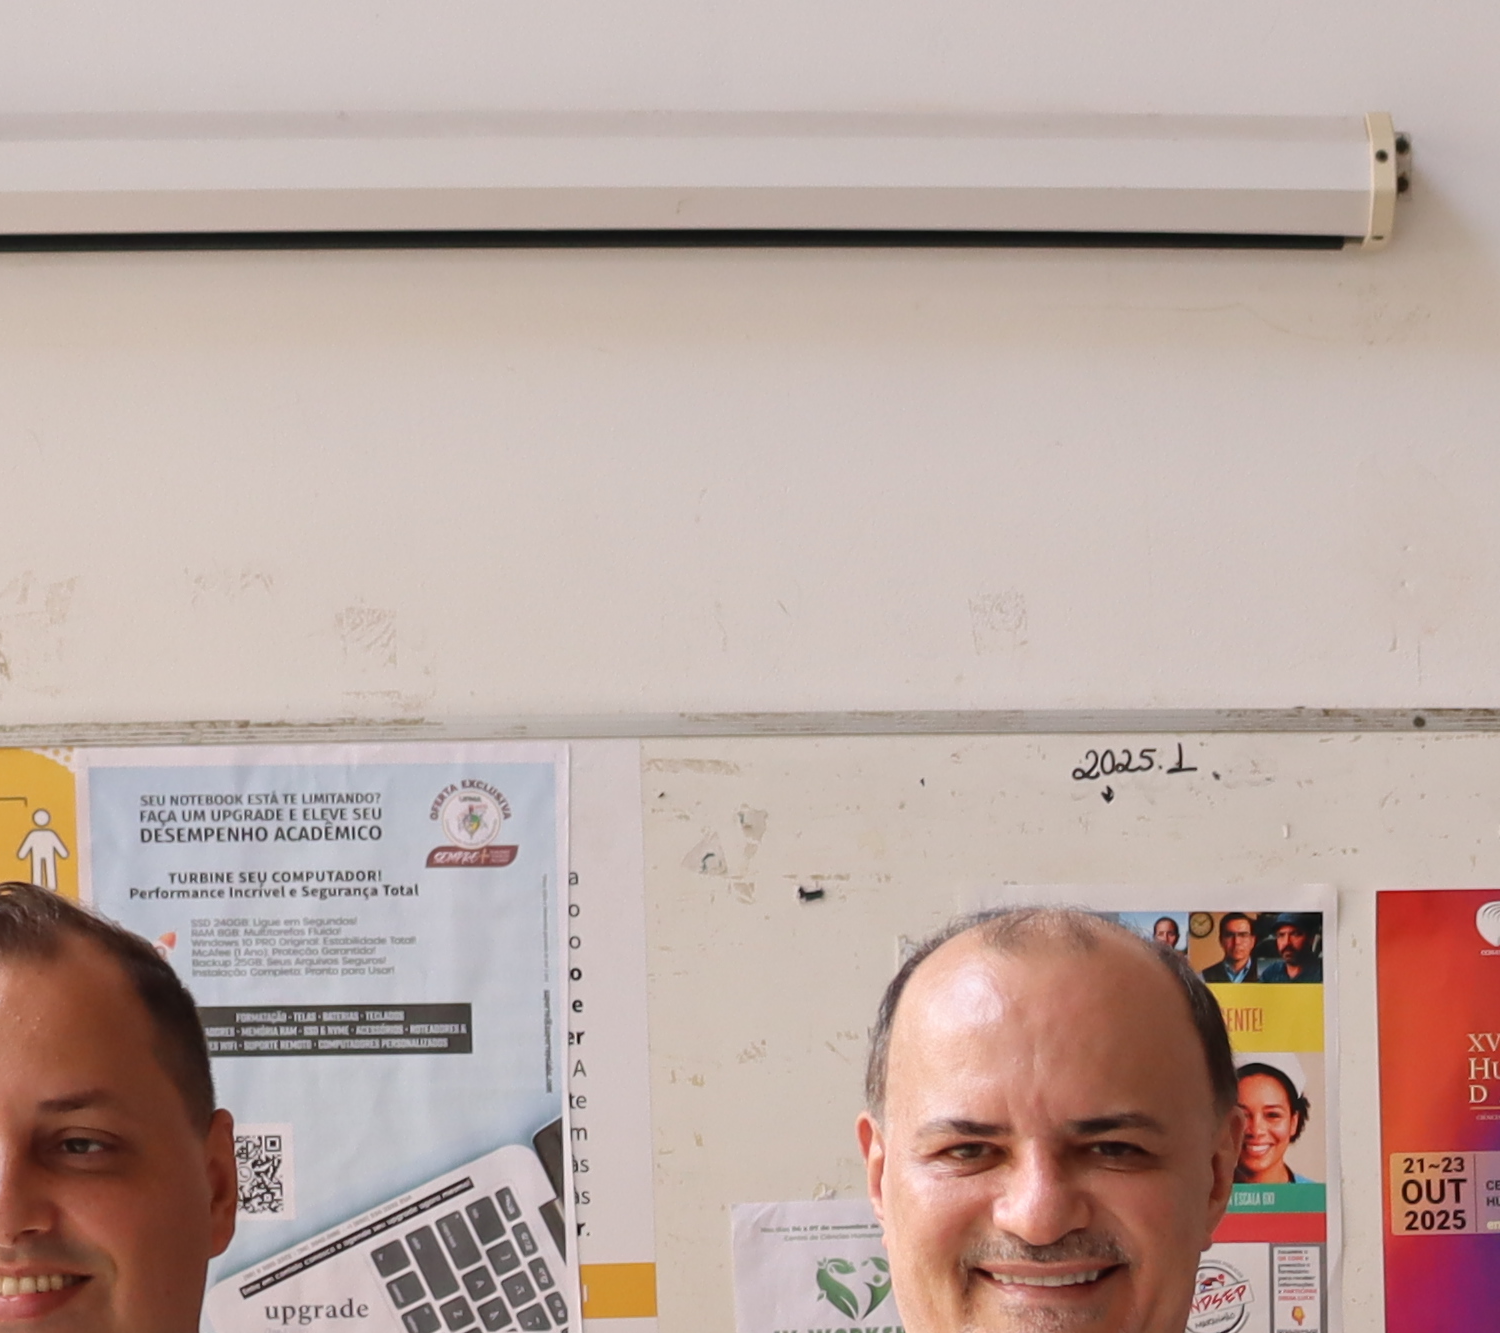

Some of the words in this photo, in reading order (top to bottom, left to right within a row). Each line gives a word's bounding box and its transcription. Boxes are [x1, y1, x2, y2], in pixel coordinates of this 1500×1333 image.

[1071, 742, 1198, 780] 2025.1
[140, 795, 165, 806] SEU
[169, 794, 243, 805] NOTEBOOK
[247, 791, 279, 804] ESTÁ
[283, 793, 298, 804] TE
[301, 792, 381, 804] LIMITANDO?
[140, 827, 268, 843] DESEMPENHO
[274, 822, 382, 842] ACADÊMICO
[168, 872, 233, 884] TURBINE
[238, 871, 267, 883] SEU
[272, 870, 382, 883] COMPUTADOR!
[129, 888, 225, 899] Performance
[229, 884, 286, 898] Incrível
[289, 888, 297, 897] e
[301, 885, 380, 901] Segurança
[384, 883, 419, 897] Total
[1403, 1157, 1465, 1174] 21~23
[1401, 1178, 1467, 1205] OUT
[1405, 1210, 1466, 1231] 2025
[264, 1298, 369, 1325] upgrade
